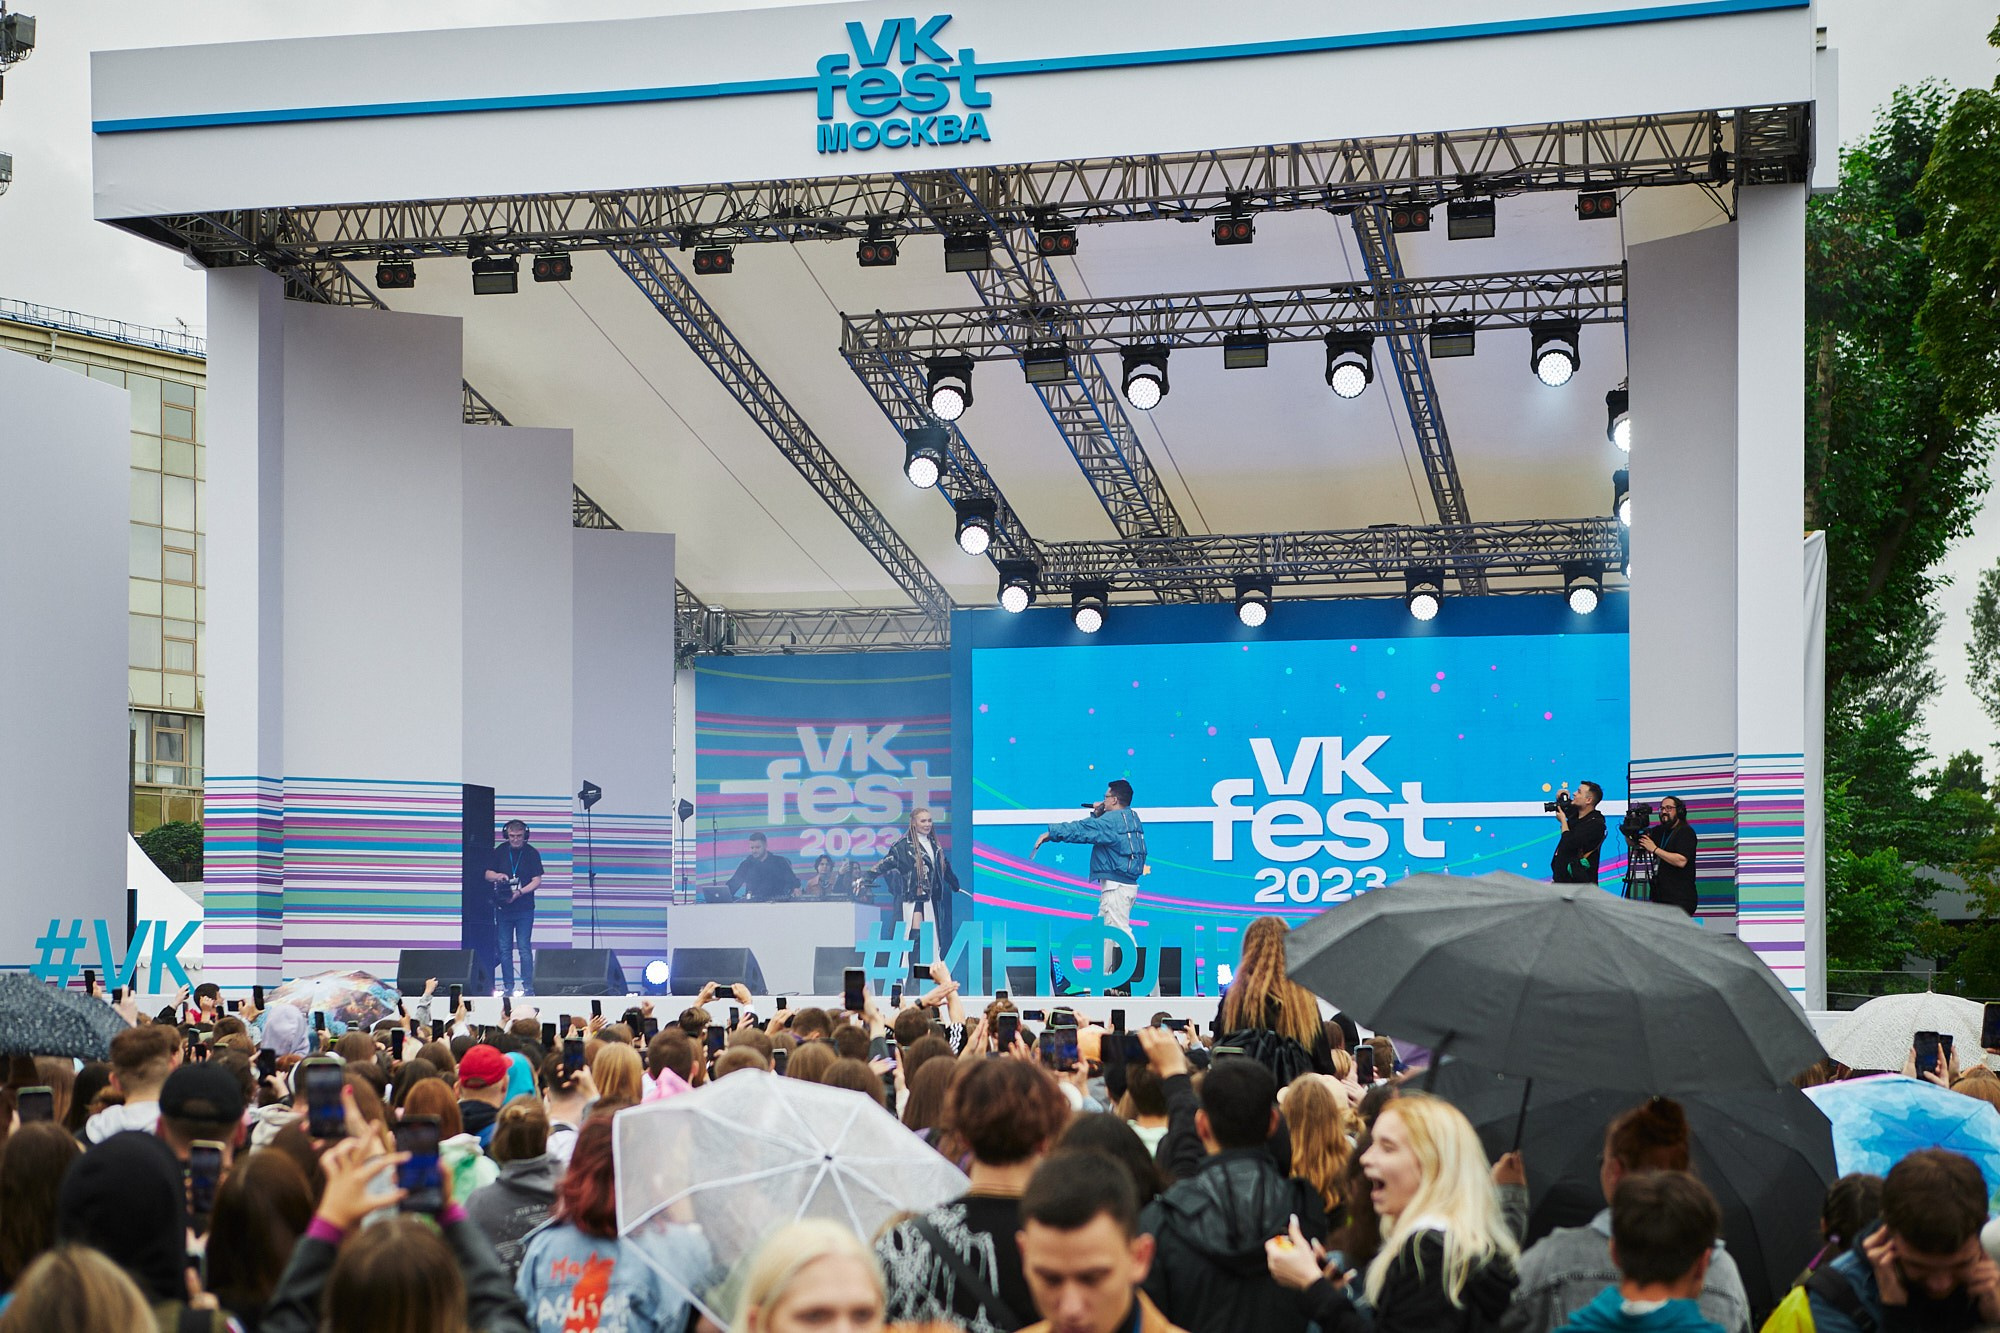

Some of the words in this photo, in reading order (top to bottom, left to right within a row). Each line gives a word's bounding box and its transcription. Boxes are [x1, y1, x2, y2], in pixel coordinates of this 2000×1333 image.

[845, 14, 954, 68] VK
[816, 48, 992, 120] fest
[816, 112, 991, 153] МОСКВА
[796, 724, 905, 772] VK
[1249, 735, 1393, 796] VK
[766, 759, 947, 825] fest
[1211, 778, 1446, 862] fest
[800, 827, 902, 857] 2023
[29, 919, 204, 994] #VK
